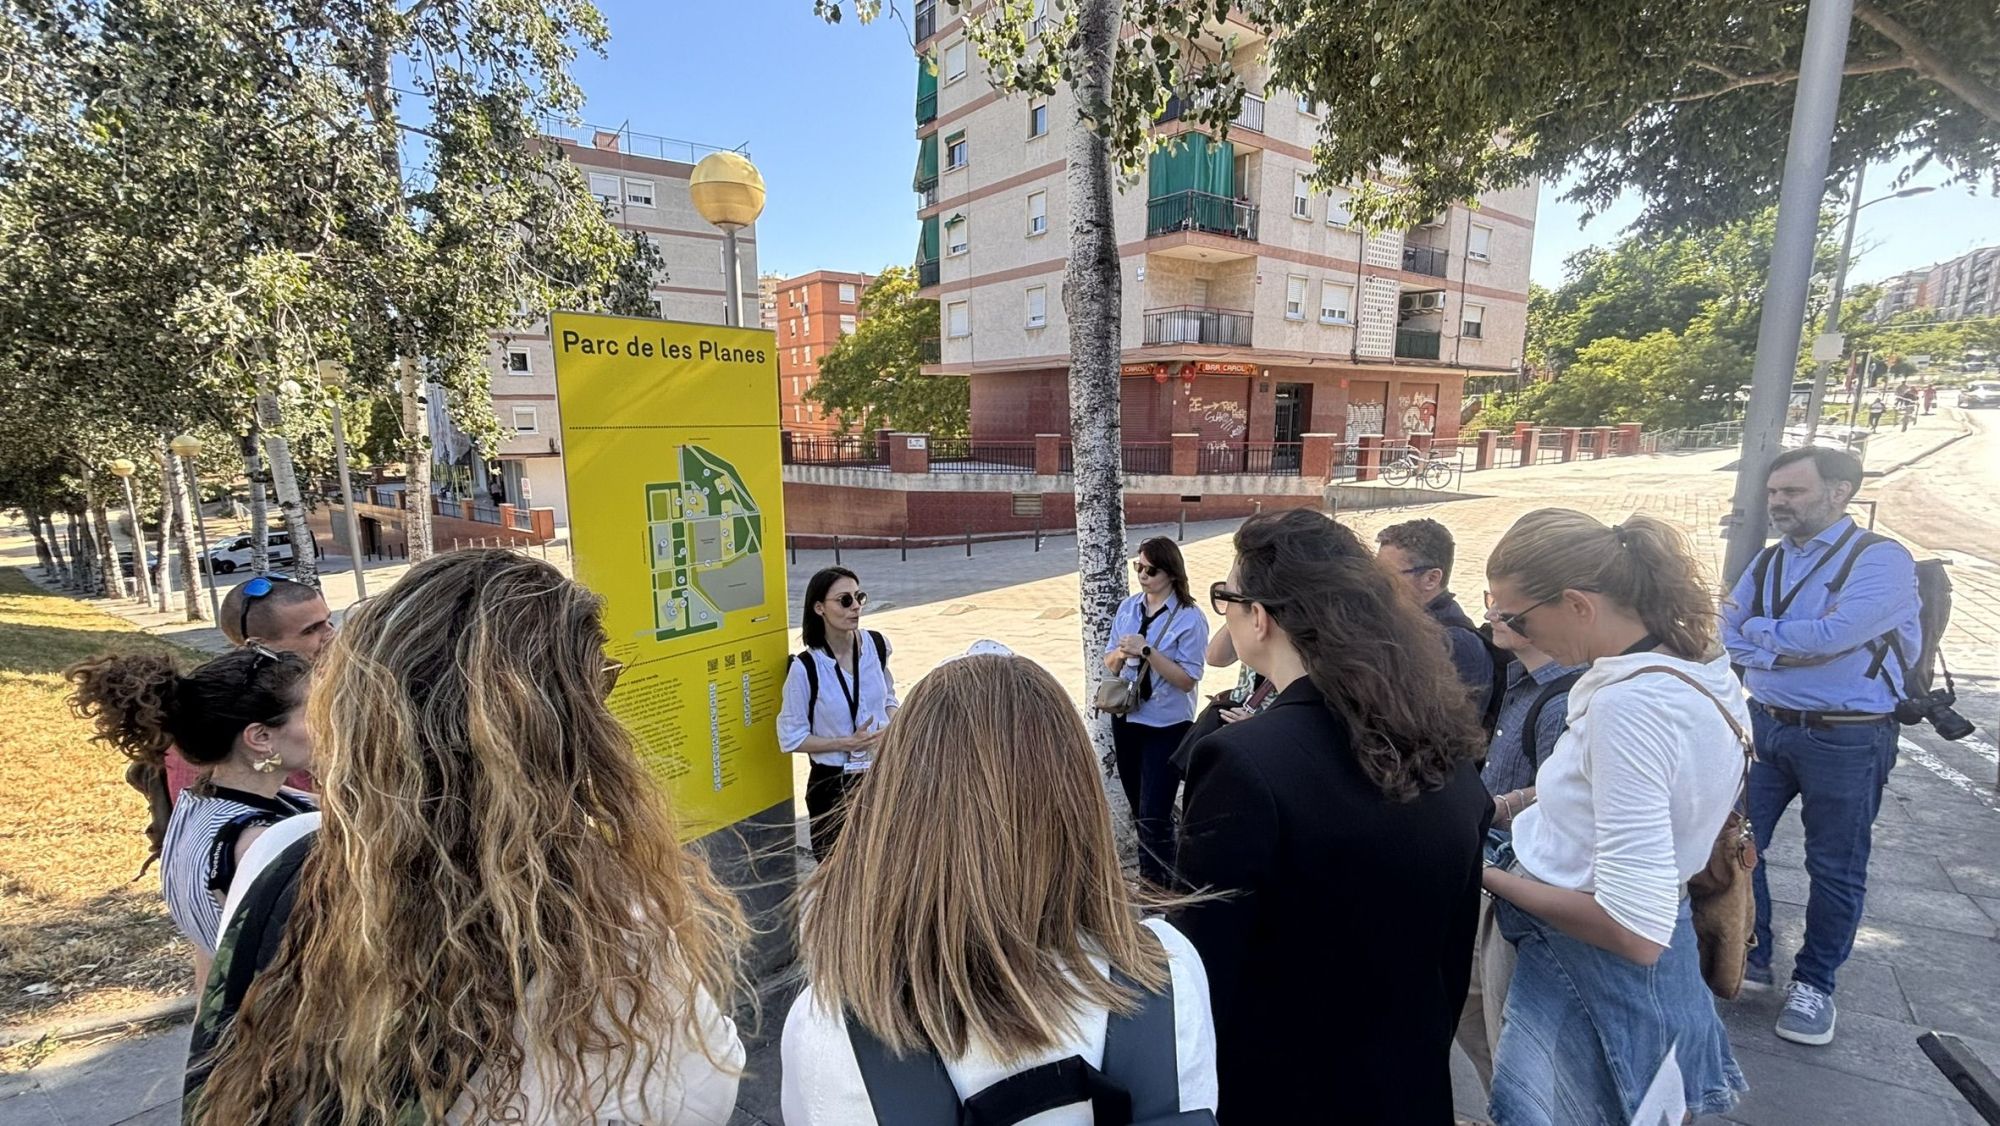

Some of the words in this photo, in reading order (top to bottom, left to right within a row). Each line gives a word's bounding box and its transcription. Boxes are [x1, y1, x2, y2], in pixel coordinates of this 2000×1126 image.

[563, 330, 619, 356] Parc
[626, 335, 654, 358] de
[660, 336, 693, 360] les
[699, 339, 766, 364] Planes
[1205, 363, 1221, 372] BAR
[1222, 363, 1246, 373] CAROL
[210, 841, 224, 879] Quechua
